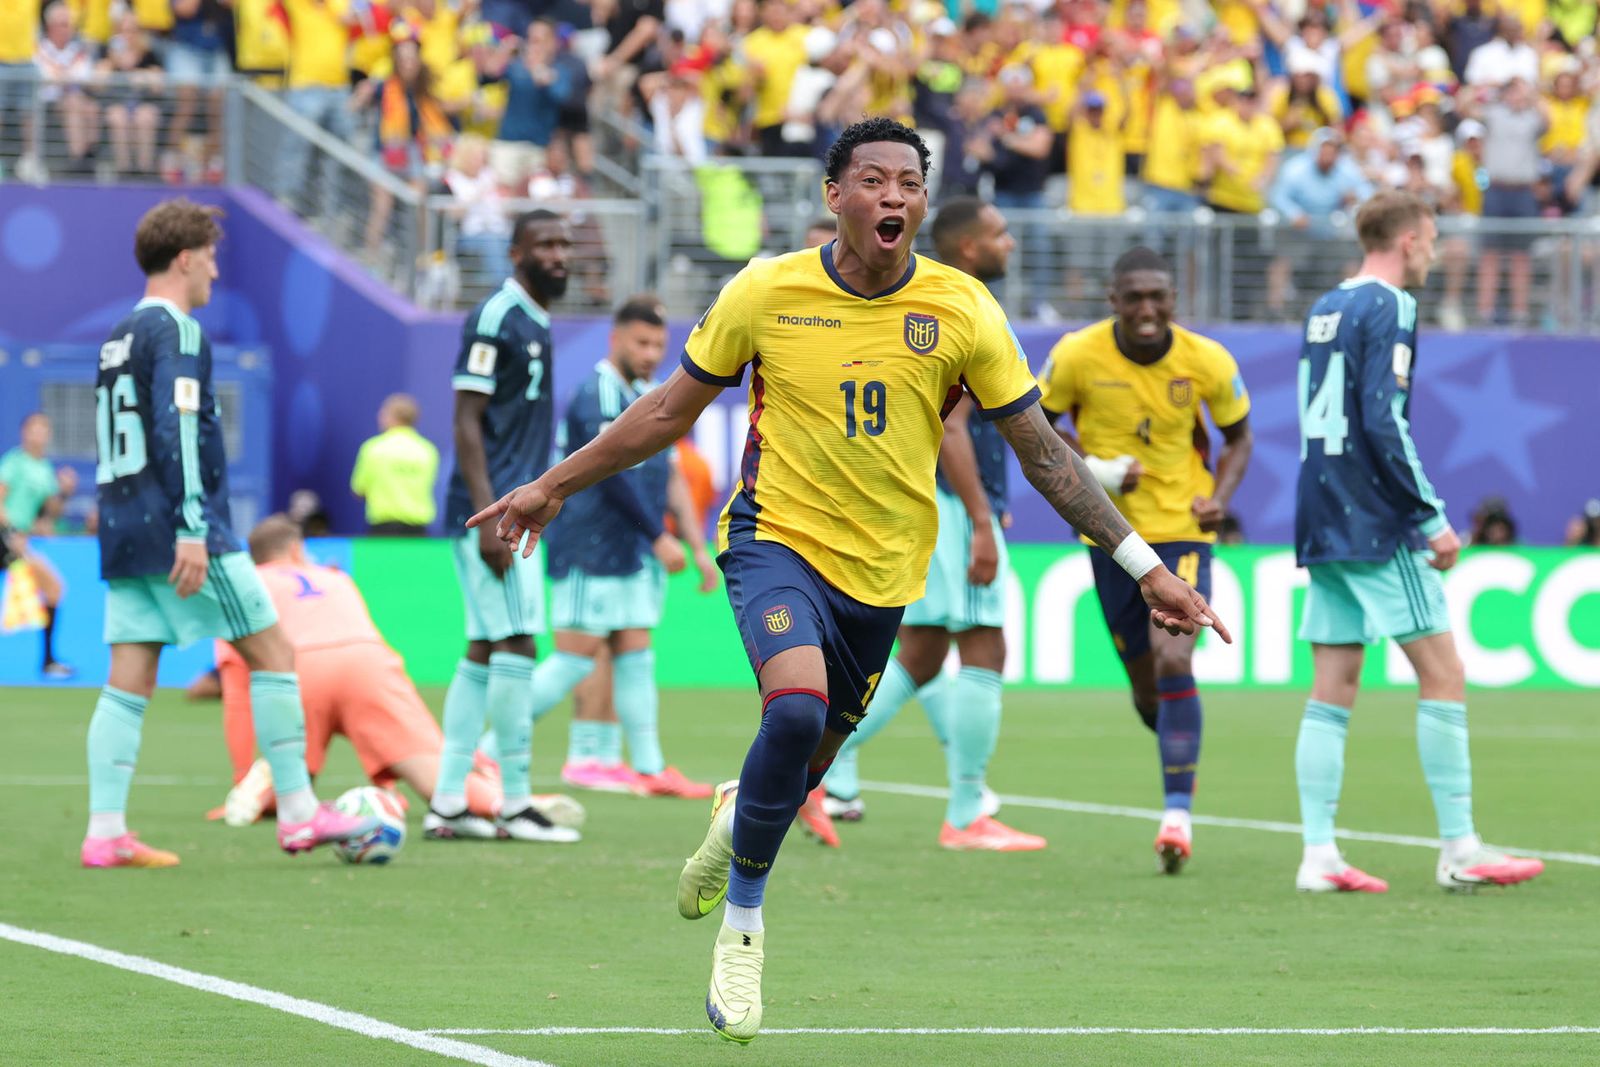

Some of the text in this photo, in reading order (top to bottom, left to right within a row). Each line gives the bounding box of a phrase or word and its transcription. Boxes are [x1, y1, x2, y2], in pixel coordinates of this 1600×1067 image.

[777, 315, 841, 328] marathon
[525, 358, 544, 400] 2
[96, 374, 147, 485] 16
[839, 380, 887, 438] 19
[1298, 351, 1349, 463] 14
[296, 574, 323, 598] 1
